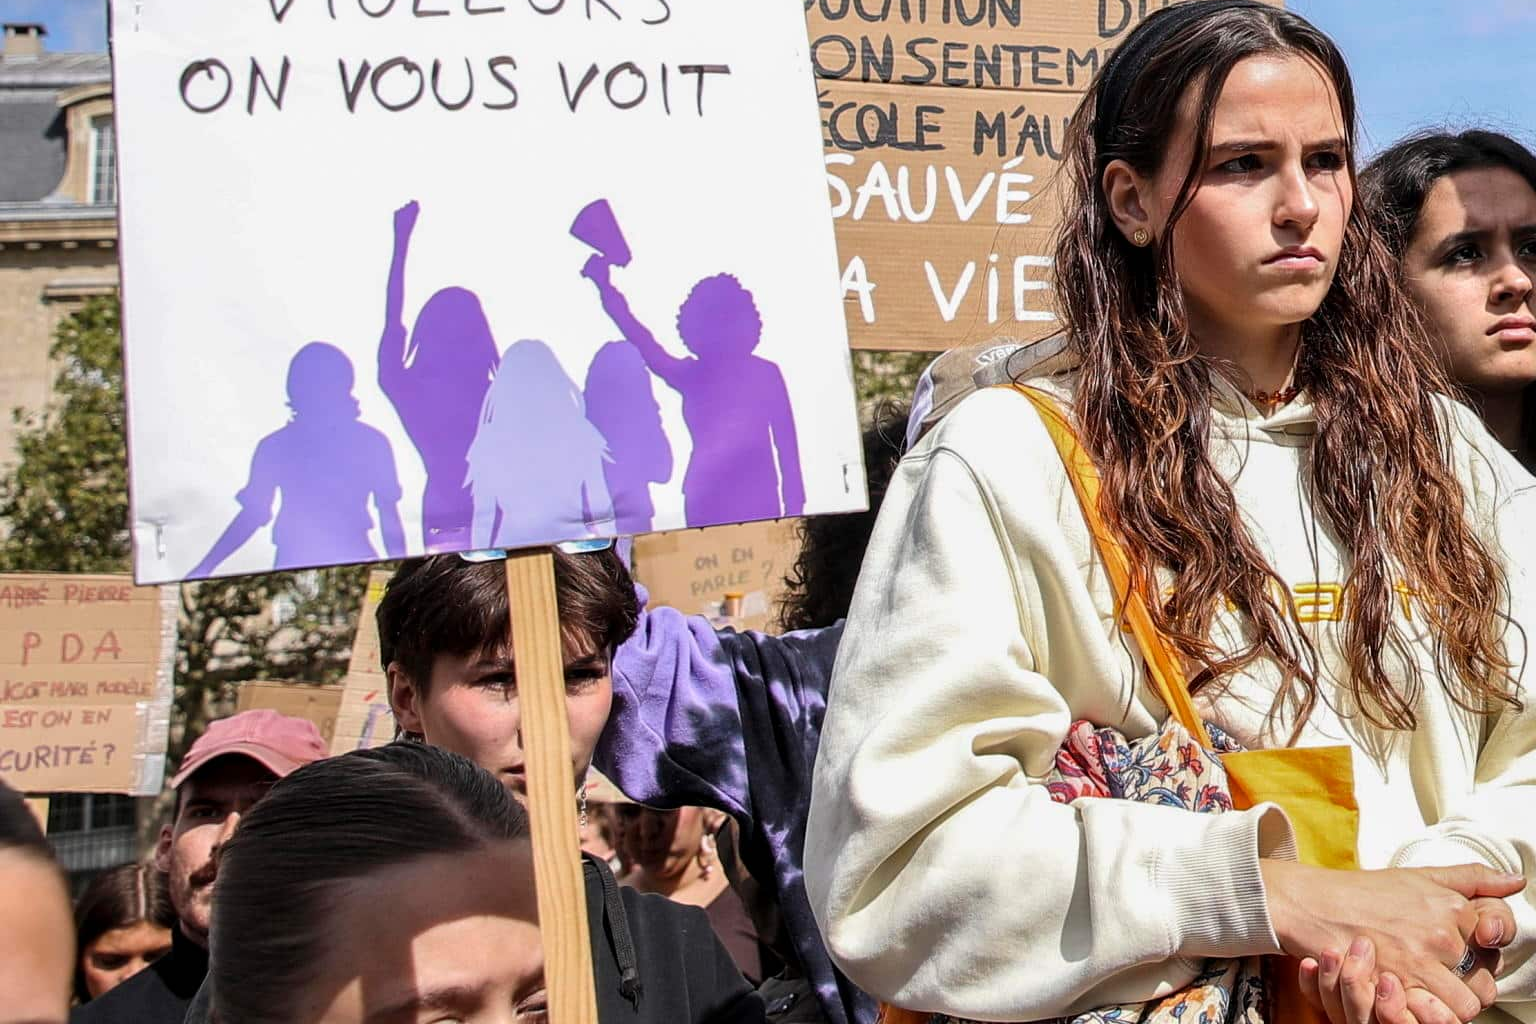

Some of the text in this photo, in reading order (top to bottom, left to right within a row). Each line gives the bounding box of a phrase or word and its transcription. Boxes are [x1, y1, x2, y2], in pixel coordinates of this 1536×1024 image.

[178, 54, 731, 117] ON VOUS VOIT
[825, 153, 1034, 225] SAUVÉ
[690, 569, 751, 595] PARLE
[41, 709, 72, 728] ON
[81, 708, 112, 726] EN
